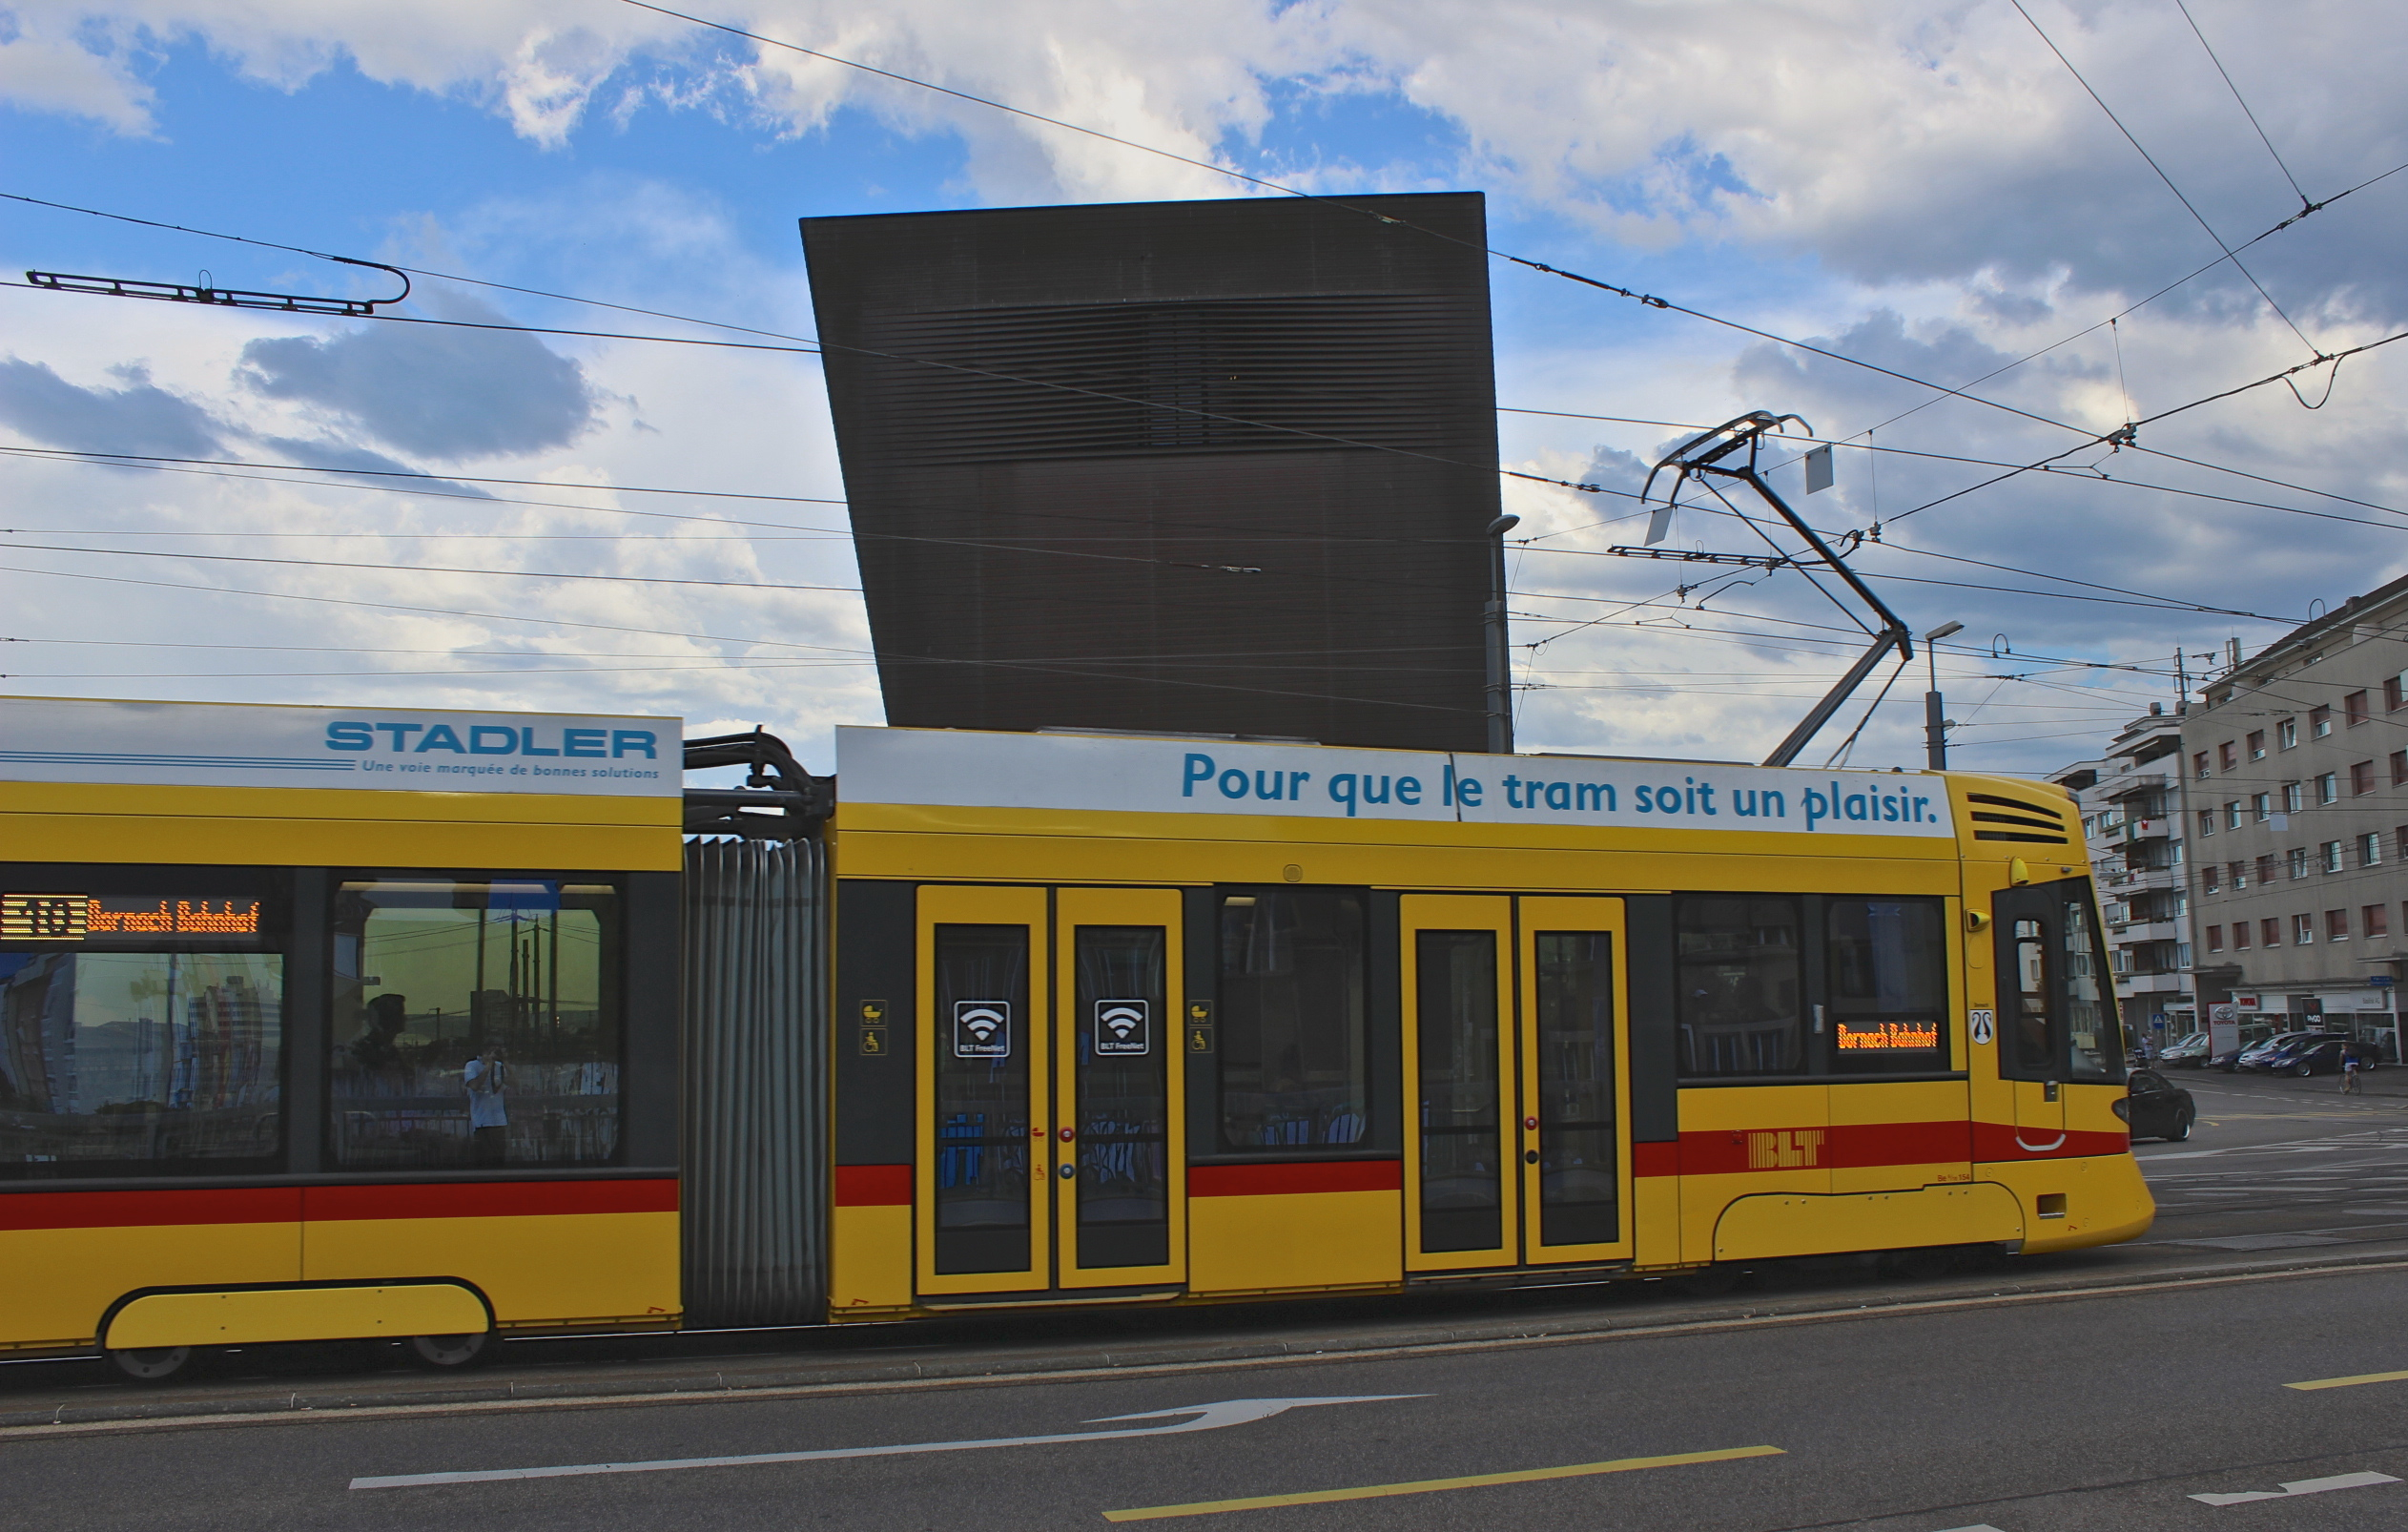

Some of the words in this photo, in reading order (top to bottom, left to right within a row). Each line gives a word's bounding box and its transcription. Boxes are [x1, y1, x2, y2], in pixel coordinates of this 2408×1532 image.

[324, 721, 657, 759] STADLER
[362, 760, 394, 772] Une
[400, 762, 431, 774] voie
[437, 763, 504, 777] marquée
[509, 764, 528, 776] de
[533, 765, 587, 777] bonnes
[591, 767, 660, 778] solutions
[1183, 754, 1310, 799] Pour
[1328, 772, 1422, 818] que
[1443, 765, 1482, 807] le
[1502, 775, 1616, 811] tram
[1636, 776, 1718, 815] soit
[1733, 788, 1785, 818] un
[1801, 780, 1937, 831] plaisir.
[1748, 1130, 1824, 1169] BLT
